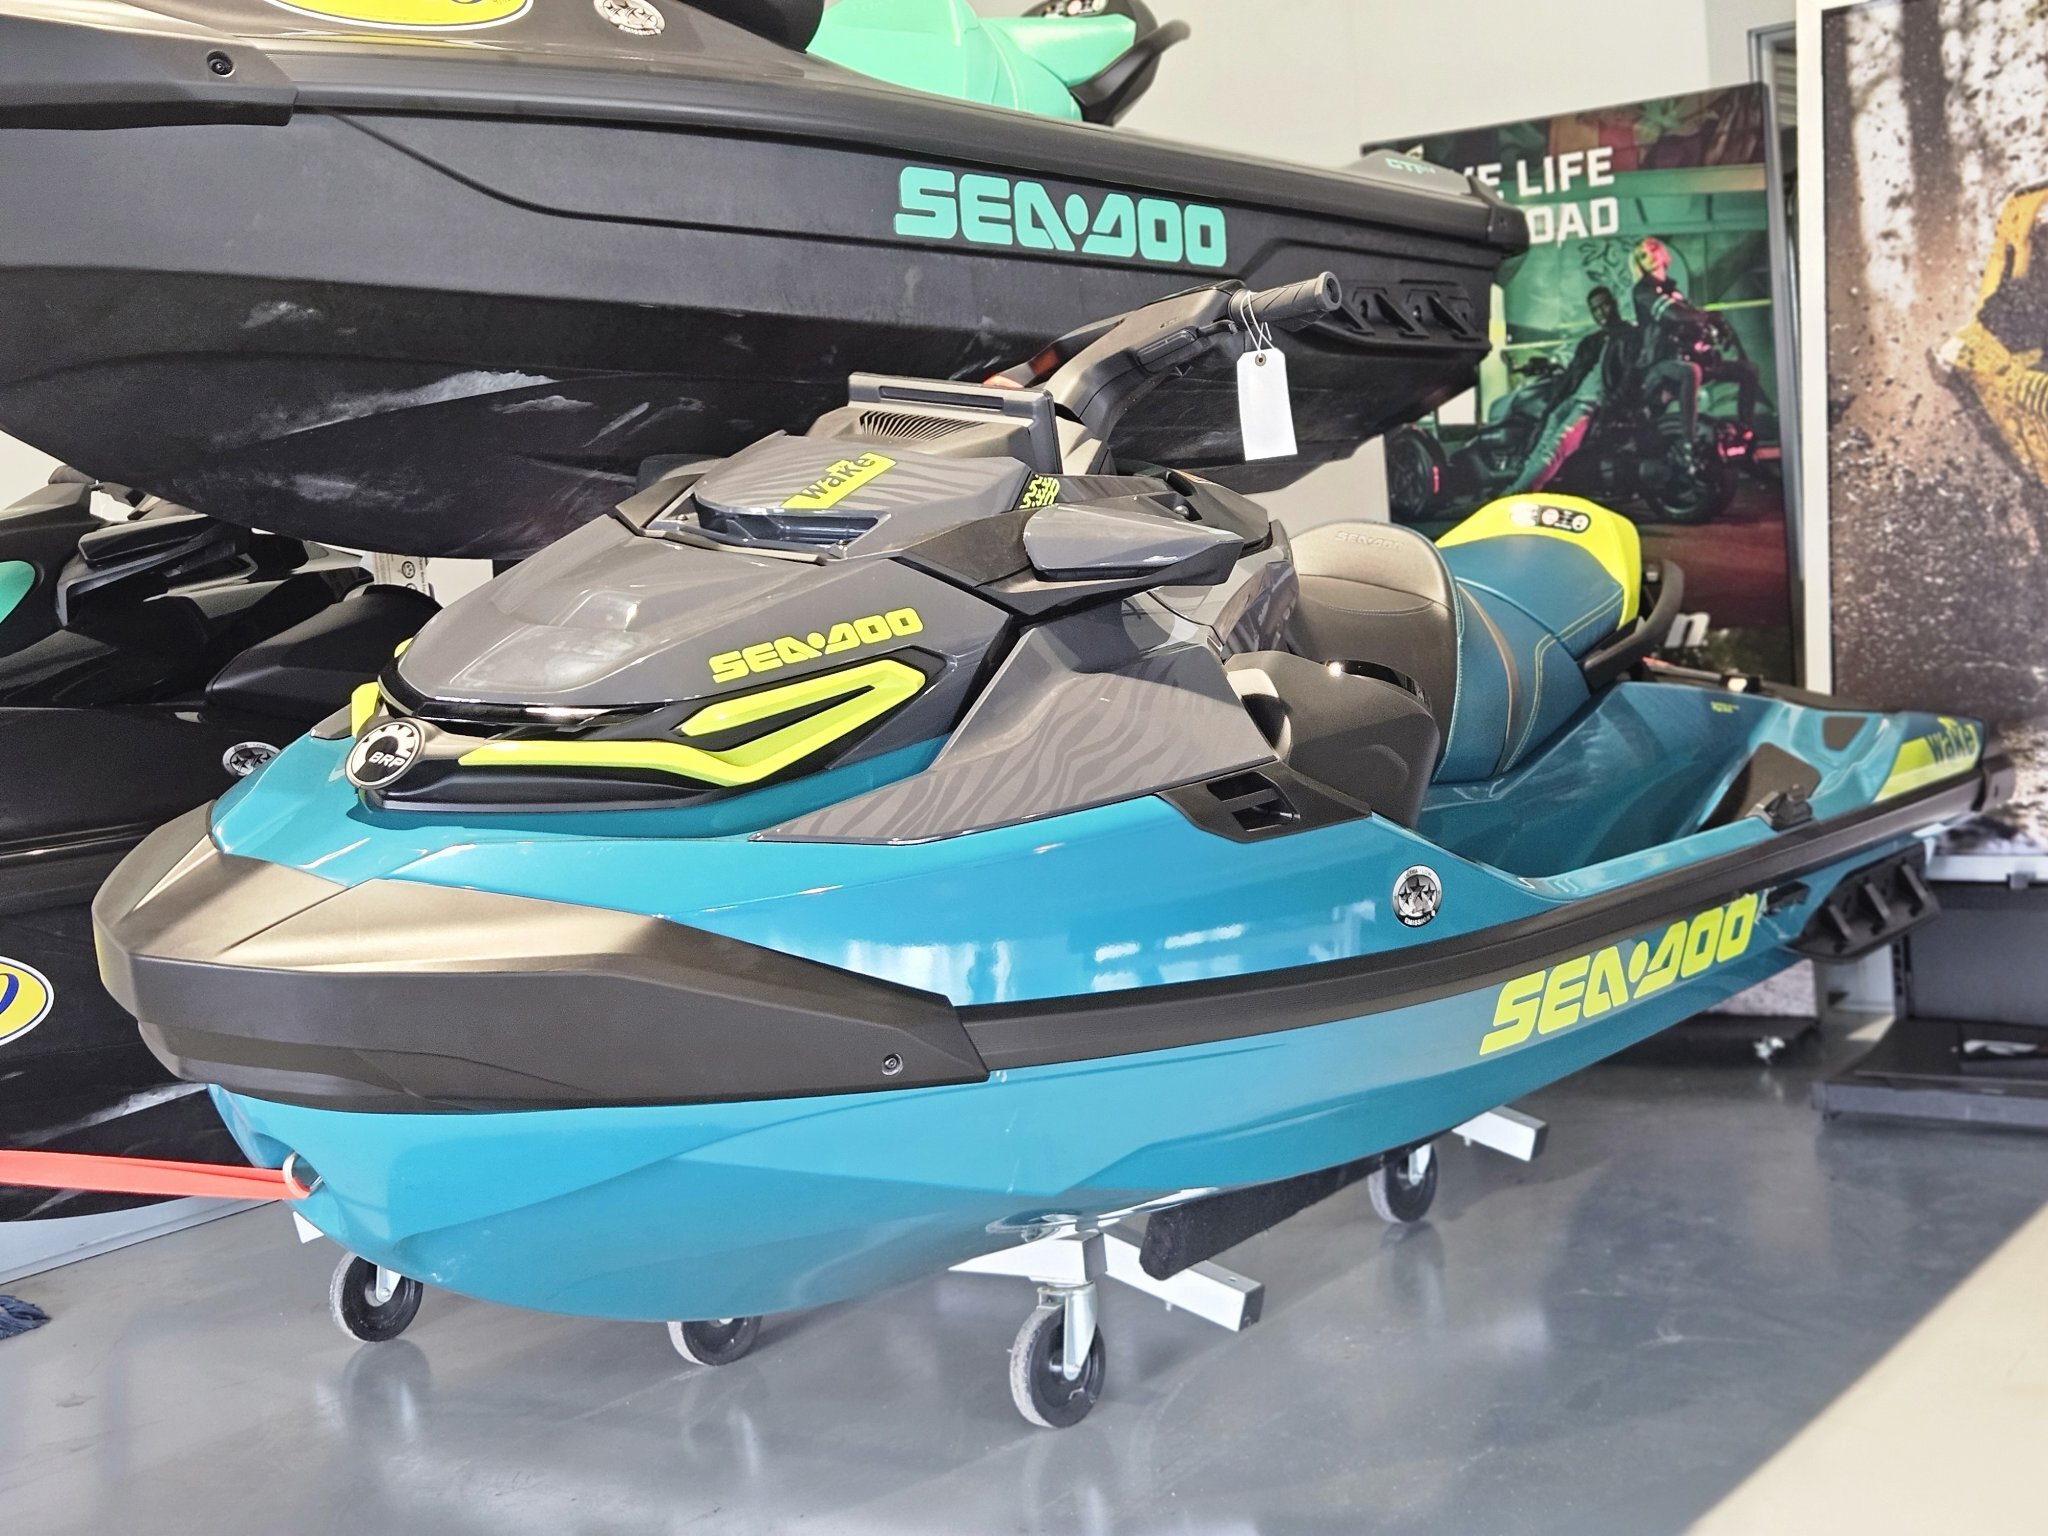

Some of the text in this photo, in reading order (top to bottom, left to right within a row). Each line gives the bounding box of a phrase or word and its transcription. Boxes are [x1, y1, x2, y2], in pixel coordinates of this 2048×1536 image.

[1516, 147, 1615, 198] LIFE
[798, 458, 876, 500] wake
[368, 751, 406, 768] BRP
